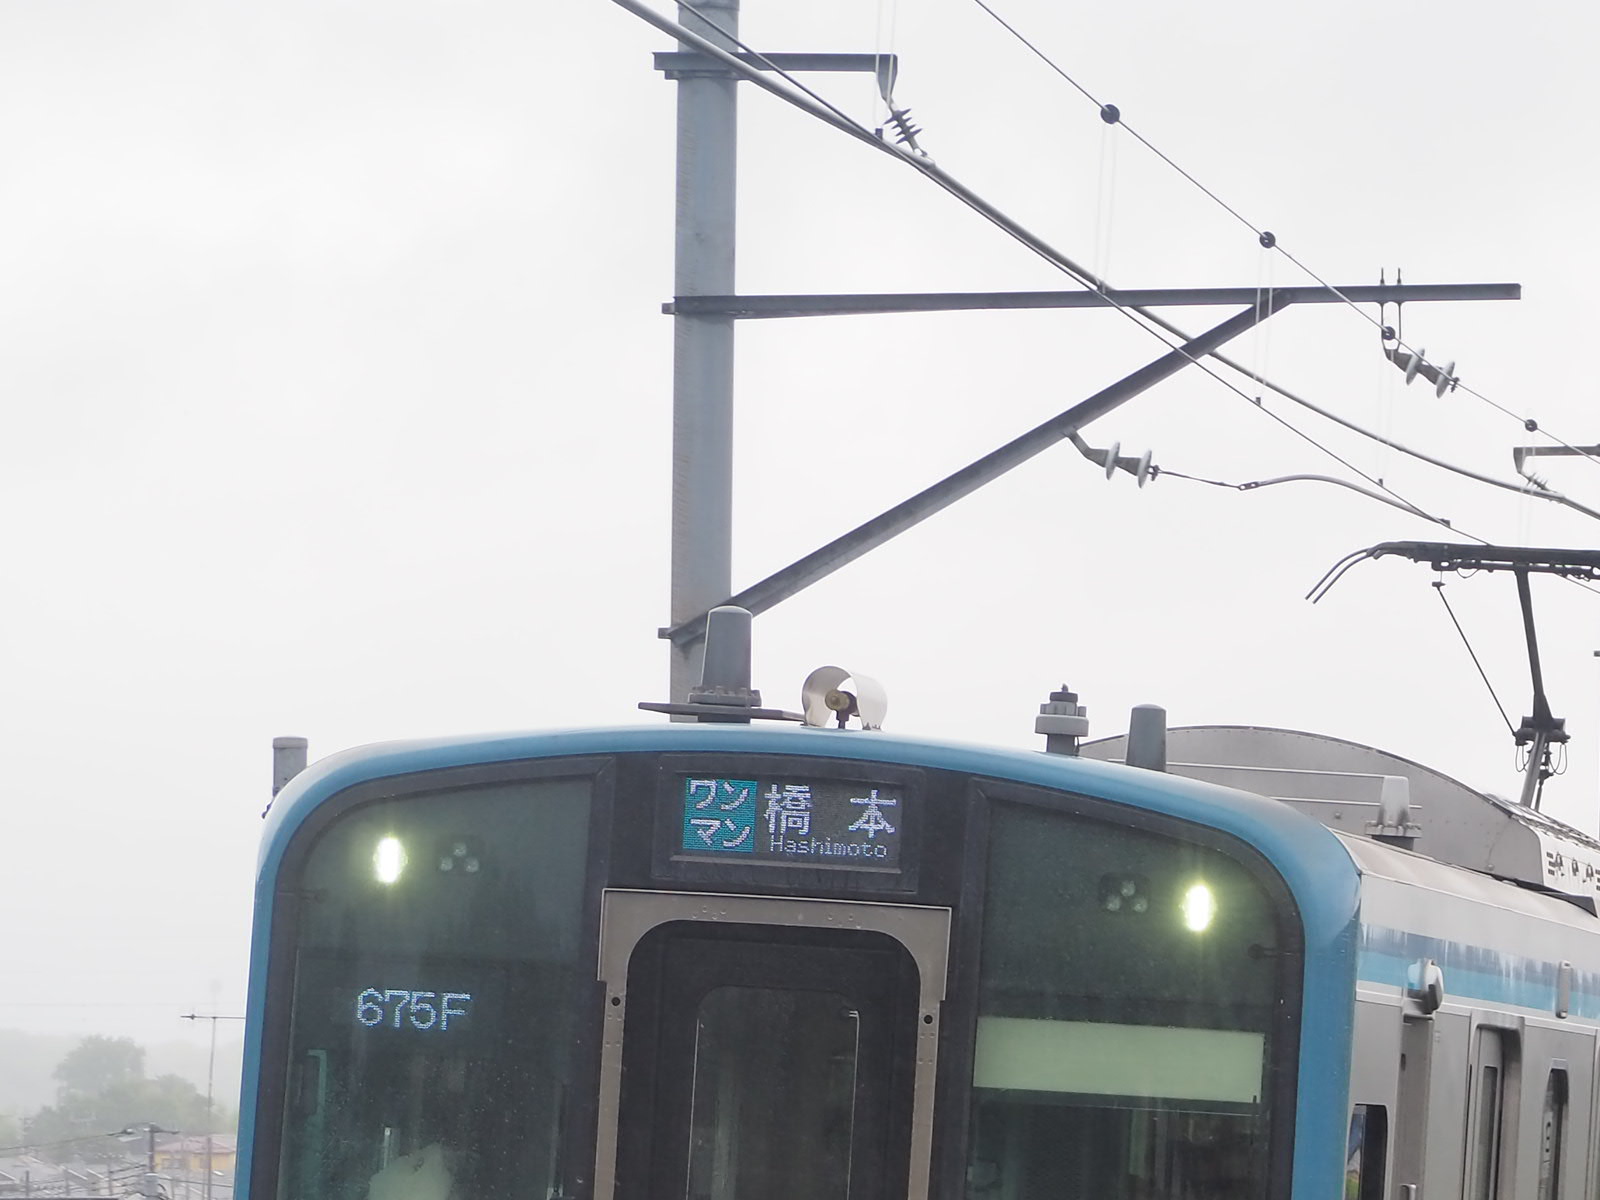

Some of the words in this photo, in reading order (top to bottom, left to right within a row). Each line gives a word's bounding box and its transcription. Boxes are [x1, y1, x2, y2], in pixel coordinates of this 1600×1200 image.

[689, 778, 750, 811] ワン
[764, 783, 897, 839] 橋本
[689, 818, 751, 848] マン
[770, 836, 888, 858] Hashimoto
[356, 987, 472, 1031] 675F
